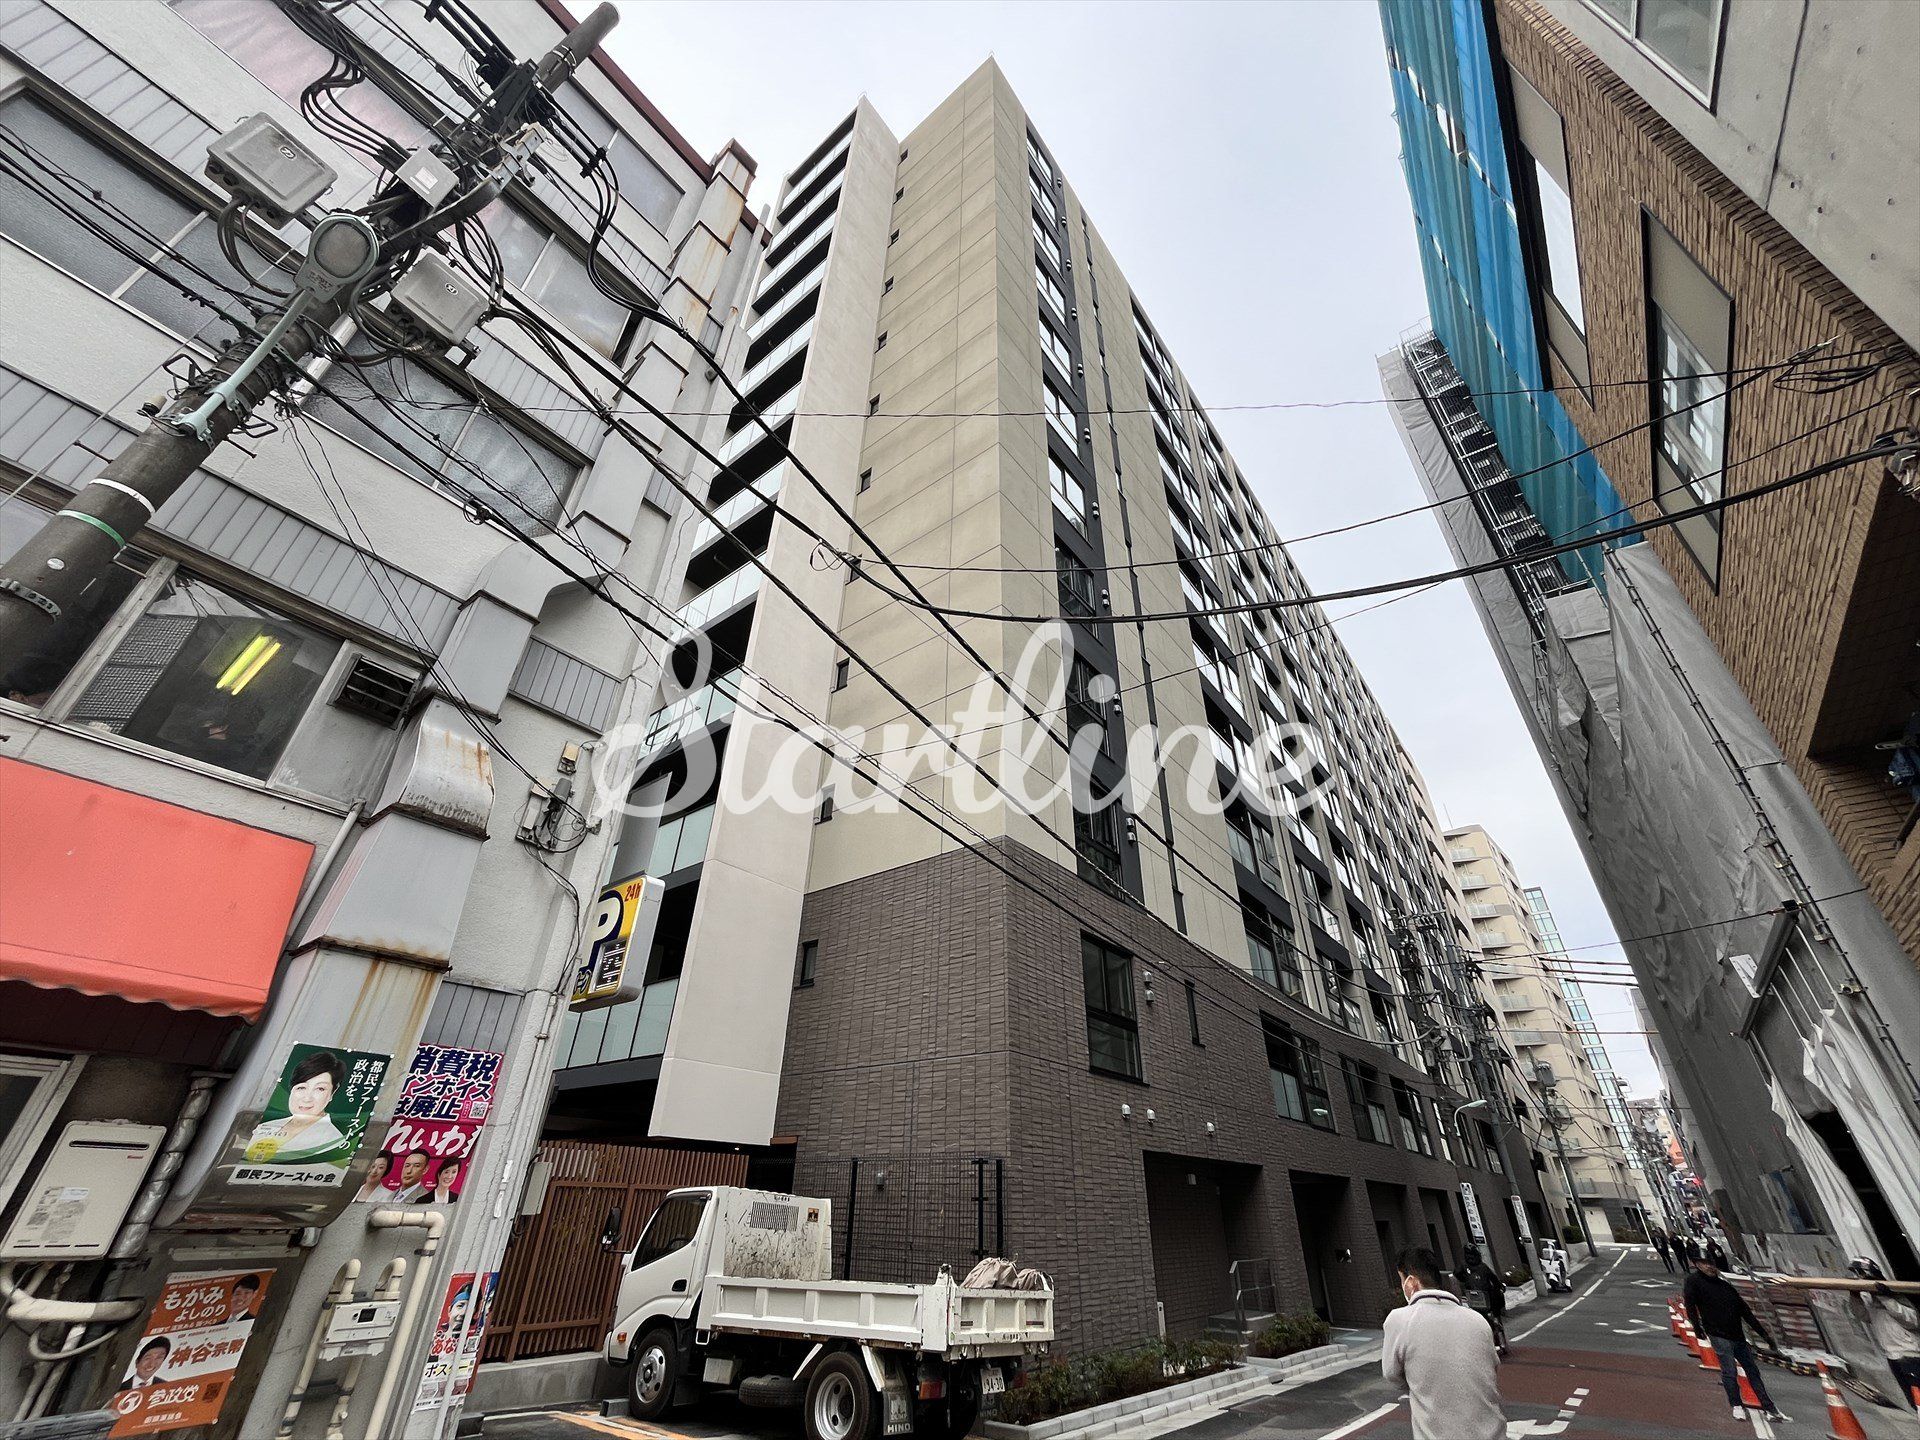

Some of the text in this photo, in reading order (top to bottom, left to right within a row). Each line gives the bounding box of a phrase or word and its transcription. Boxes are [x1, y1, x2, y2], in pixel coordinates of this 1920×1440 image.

[624, 882, 642, 902] 24h
[579, 890, 624, 970] P
[408, 1045, 502, 1081] 消費税
[338, 1060, 385, 1150] 都民ファーストの
[381, 1120, 466, 1156] れいわ
[235, 1168, 336, 1183] 都民ファーストの会
[165, 1286, 225, 1310] もがみ
[174, 1304, 226, 1323] よしのり
[424, 1363, 469, 1378] ポスー
[147, 1384, 200, 1409] 参政党
[887, 1422, 911, 1433] HINO
